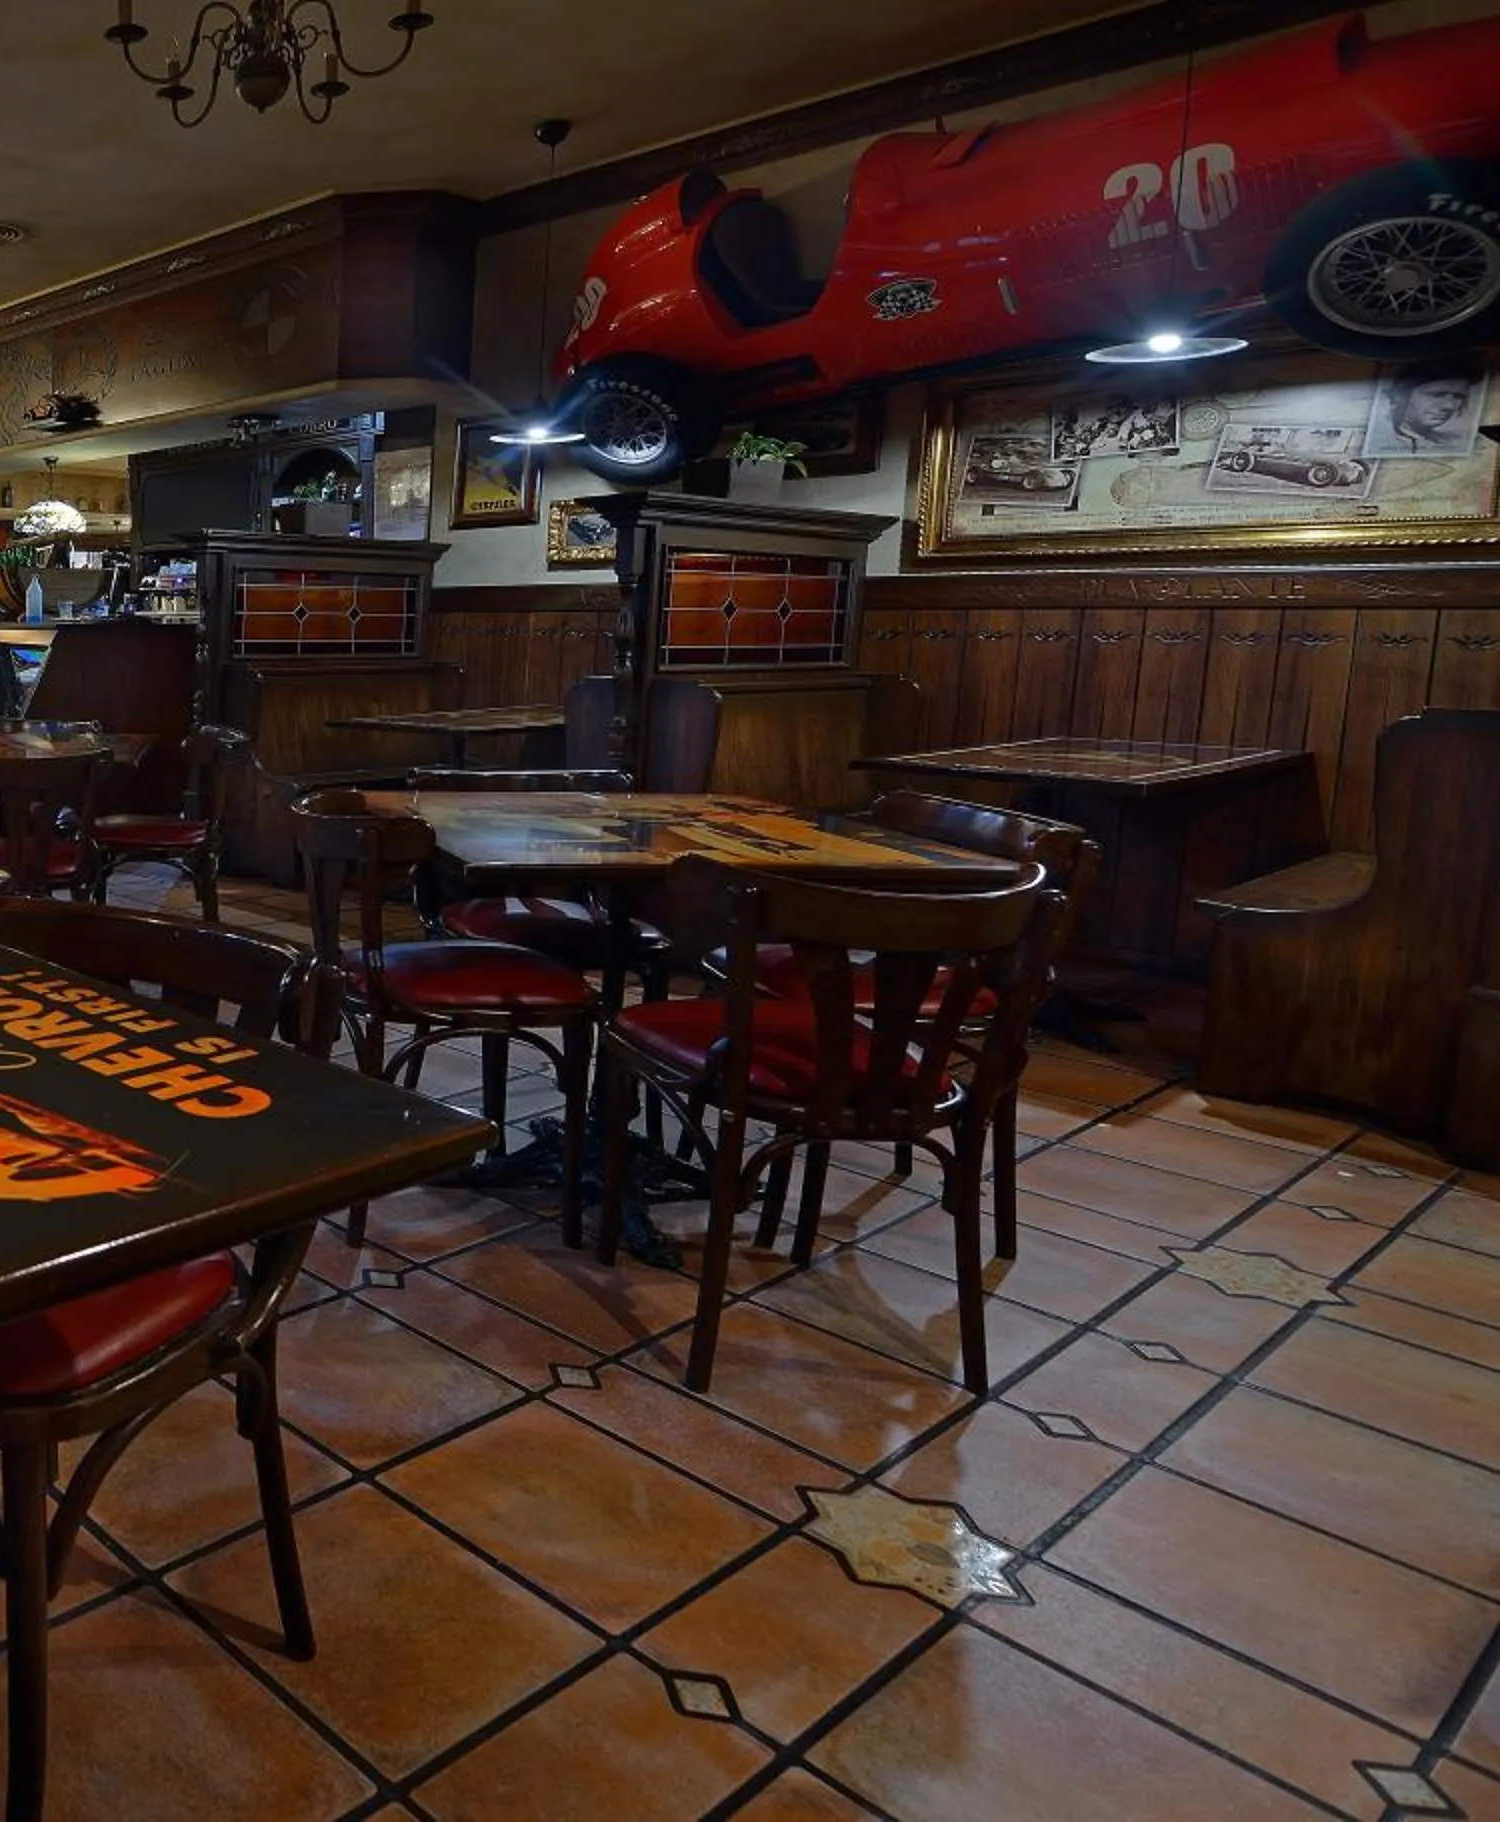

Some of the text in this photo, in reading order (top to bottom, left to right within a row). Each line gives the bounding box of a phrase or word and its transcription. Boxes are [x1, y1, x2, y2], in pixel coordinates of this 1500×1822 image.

[1103, 142, 1239, 249] 20
[1426, 192, 1500, 232] Fire
[0, 970, 260, 1064] IS FIRST!
